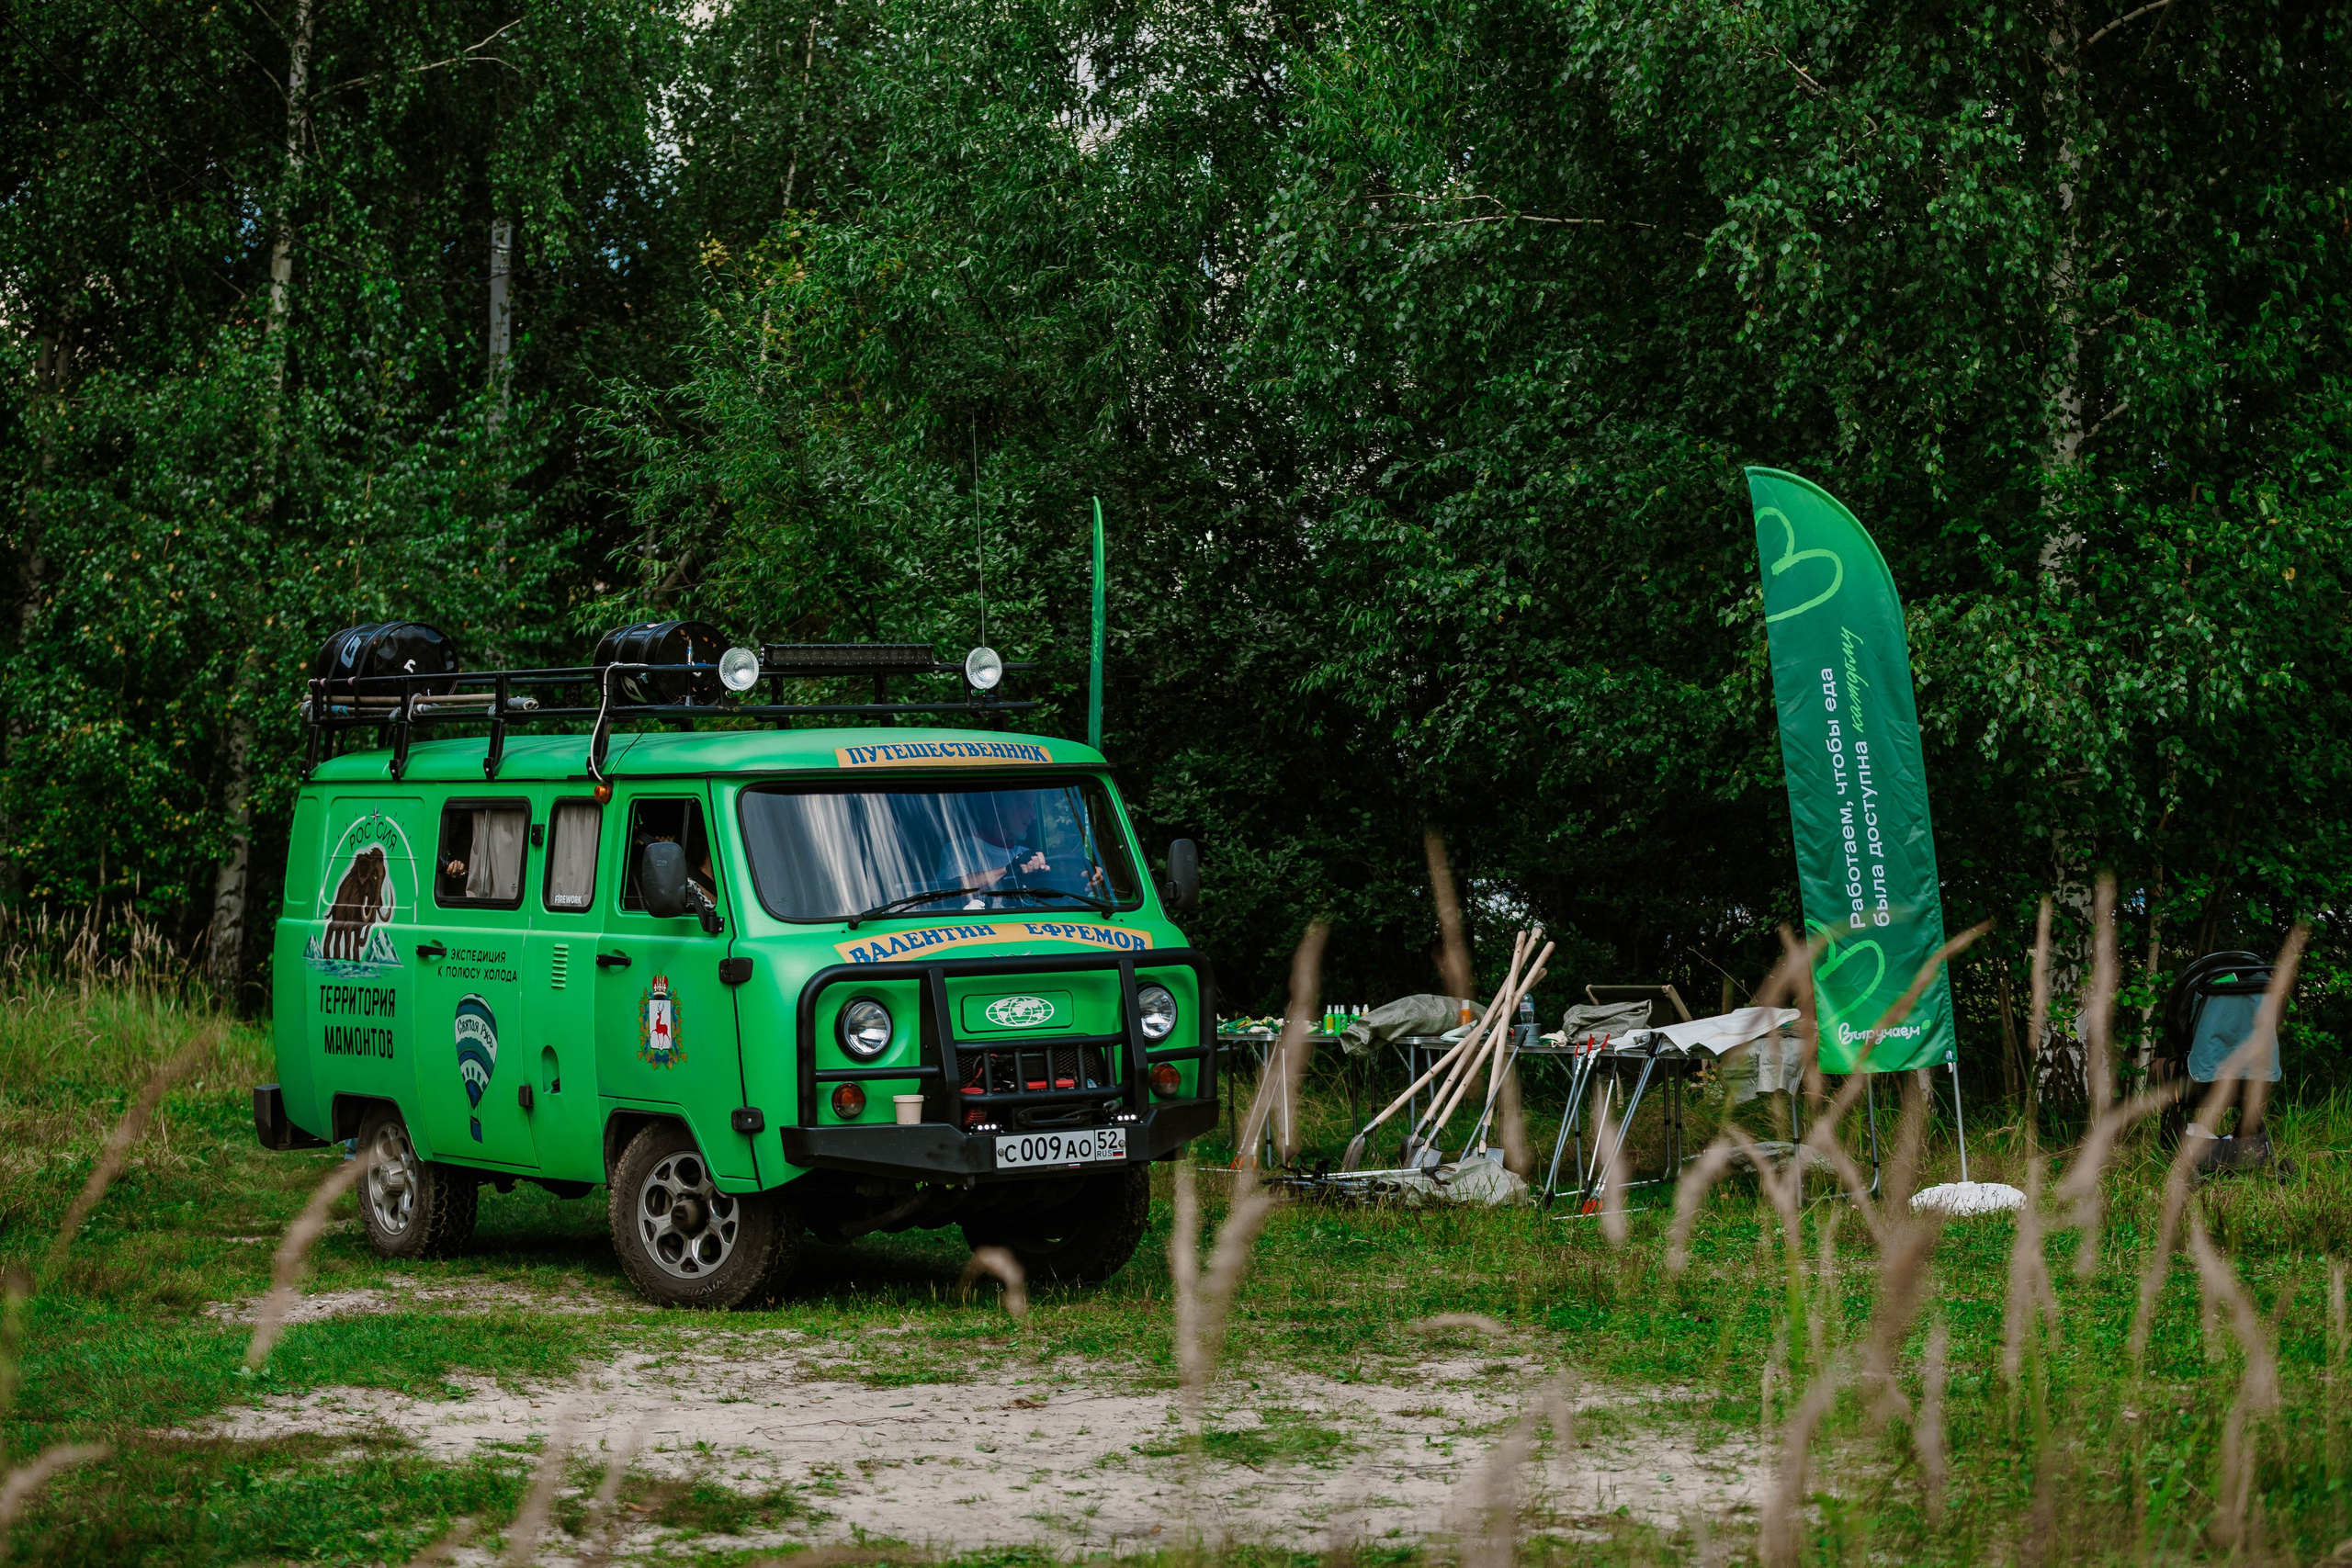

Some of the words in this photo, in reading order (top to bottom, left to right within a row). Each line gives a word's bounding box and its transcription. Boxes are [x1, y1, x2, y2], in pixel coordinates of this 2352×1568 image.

[1820, 668, 1838, 712] еда
[844, 741, 1048, 765] ПУТЕШЕСТВЕННИК
[1826, 719, 1849, 795] чтобы
[1855, 740, 1884, 858] доступна
[1839, 800, 1866, 929] Работаем,
[1871, 864, 1891, 927] была
[450, 947, 506, 964] ЭКСПЕДИЦИЯ
[848, 924, 997, 964] ВАЛЕНТИН
[1023, 922, 1147, 952] ЕФРЕМОВ
[437, 964, 443, 977] К
[446, 965, 481, 979] ПОЛЮСУ
[483, 967, 517, 983] ХОЛОДА
[319, 985, 396, 1018] ТЕРРИТОРИЯ
[324, 1024, 394, 1059] МАМОНТОВ
[1838, 1021, 1921, 1045] Выручаем
[1096, 1149, 1113, 1157] RUS
[1097, 1130, 1118, 1150] 52
